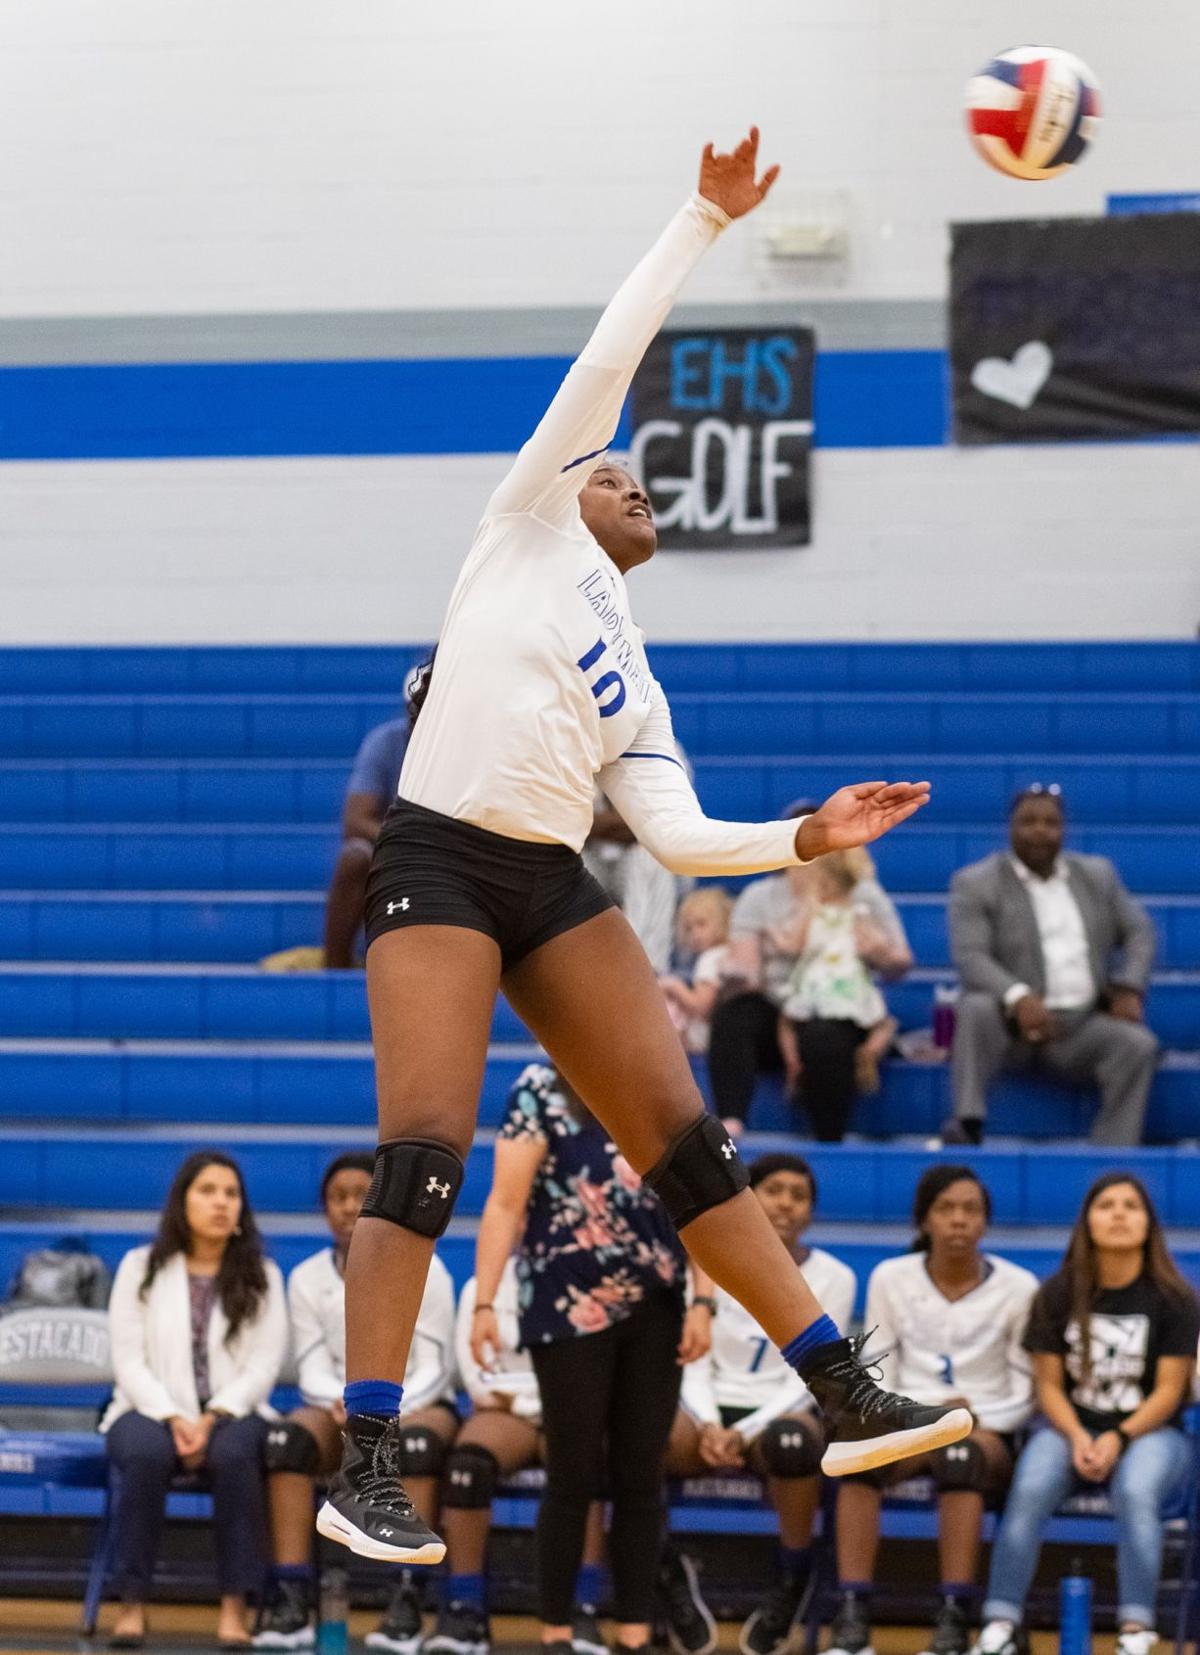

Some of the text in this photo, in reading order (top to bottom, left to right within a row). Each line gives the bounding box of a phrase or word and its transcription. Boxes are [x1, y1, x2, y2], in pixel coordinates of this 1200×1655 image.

[670, 336, 796, 415] EHS
[630, 418, 814, 535] GOLF
[577, 569, 624, 645] LADY
[576, 636, 627, 718] 10
[748, 1336, 769, 1373] 7
